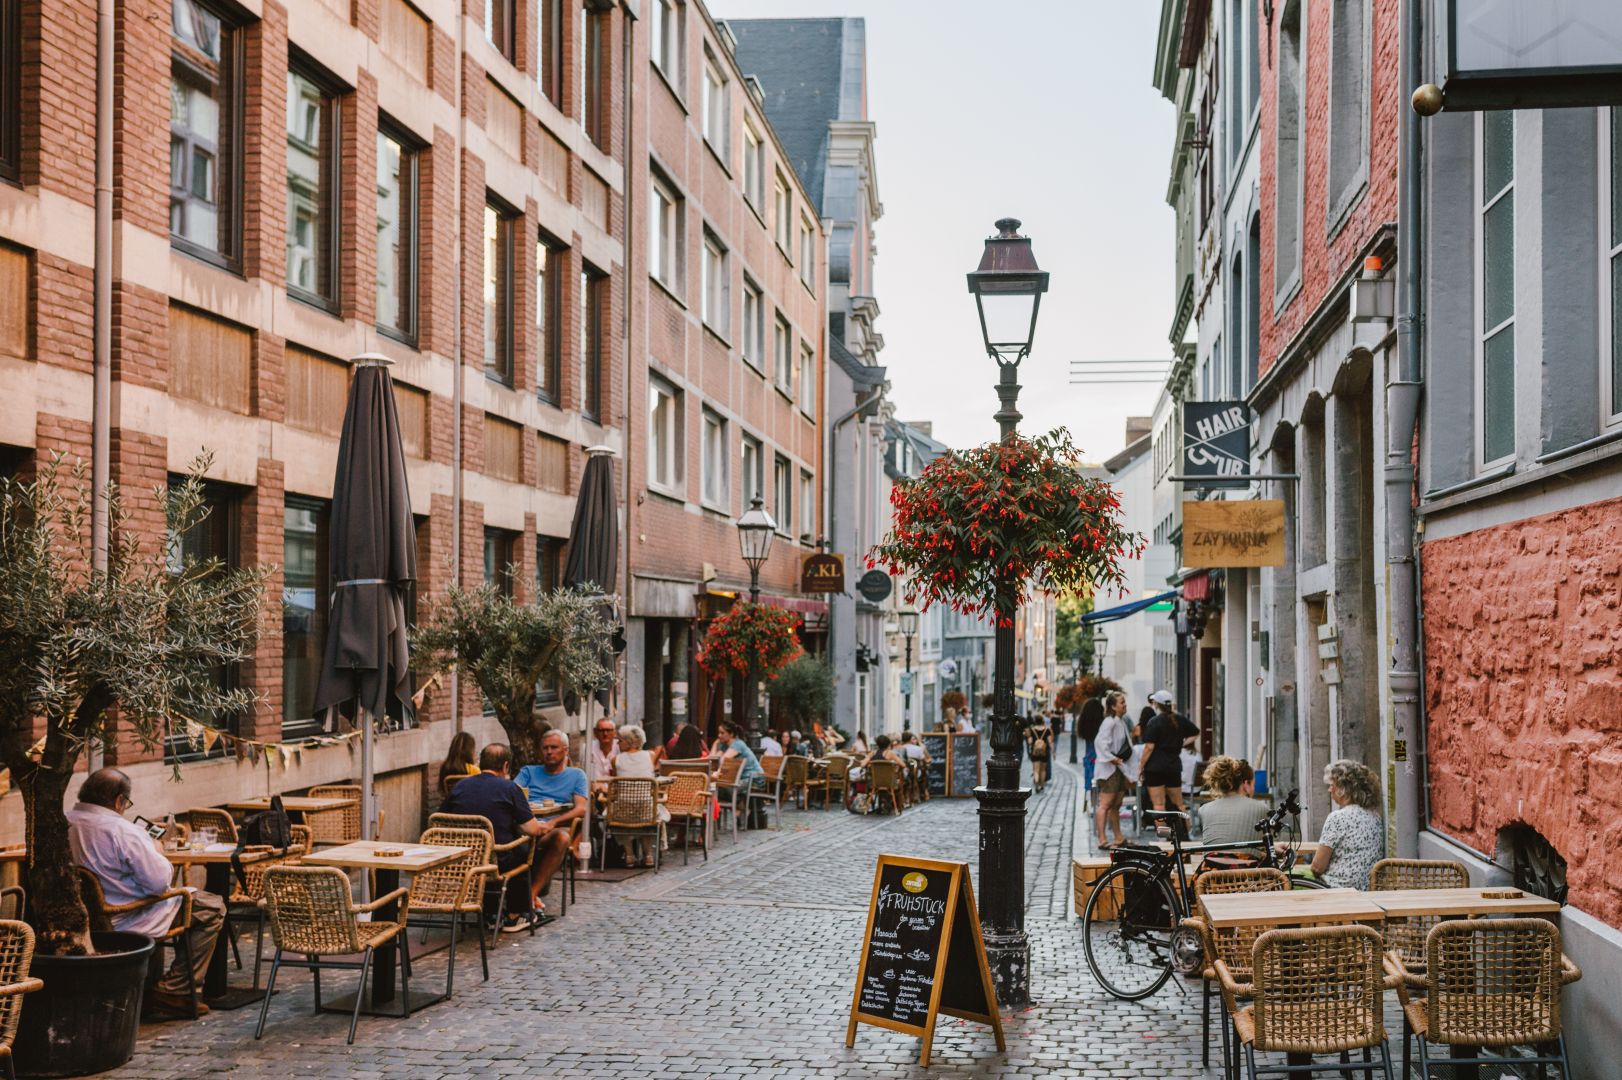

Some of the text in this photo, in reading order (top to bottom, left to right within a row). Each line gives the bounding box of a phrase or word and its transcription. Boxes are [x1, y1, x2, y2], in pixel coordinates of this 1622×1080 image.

[1196, 406, 1246, 440] HAIR
[1187, 447, 1244, 476] CLUB
[805, 563, 841, 577] AKL
[886, 892, 945, 915] FRÜHSTÜCK
[926, 915, 936, 926] Tag
